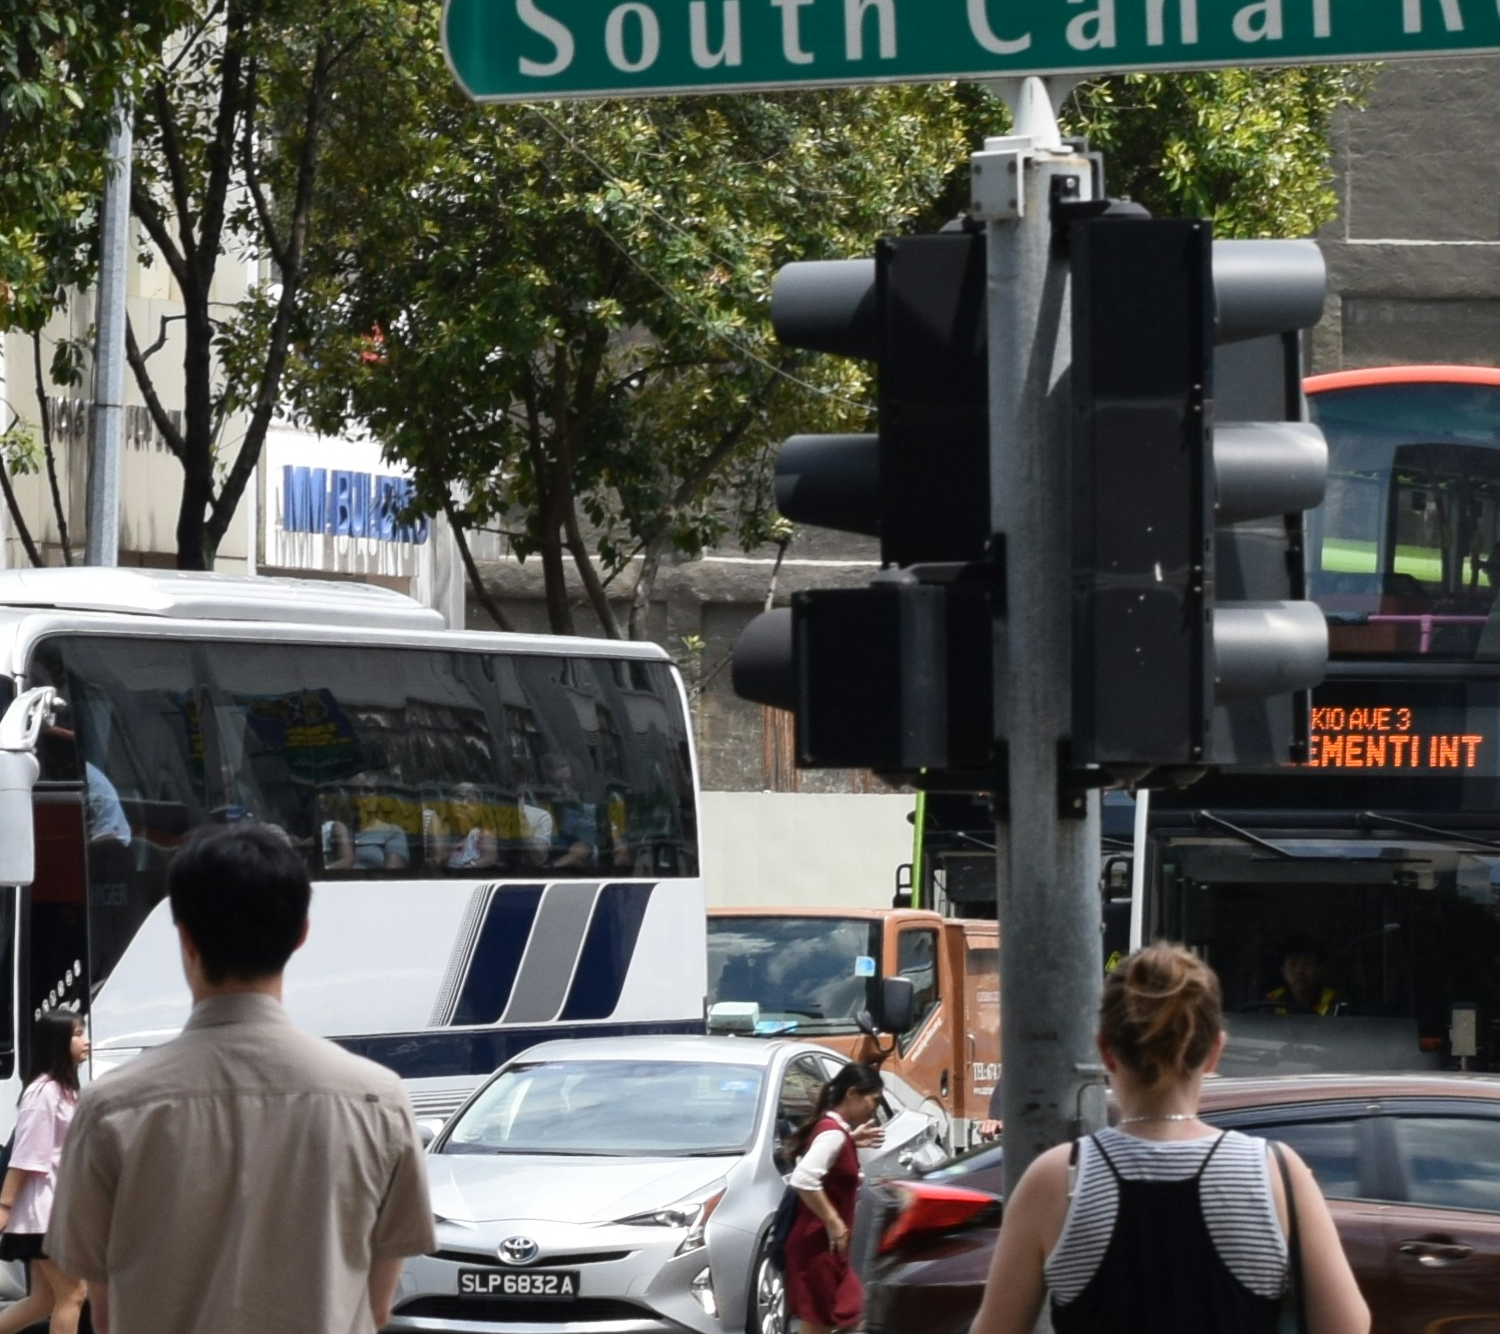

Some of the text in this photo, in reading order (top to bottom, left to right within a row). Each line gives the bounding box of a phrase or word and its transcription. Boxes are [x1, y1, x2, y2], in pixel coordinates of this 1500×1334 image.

[1349, 707, 1392, 731] AVE
[1396, 707, 1412, 731] 3
[1429, 735, 1483, 768] INT
